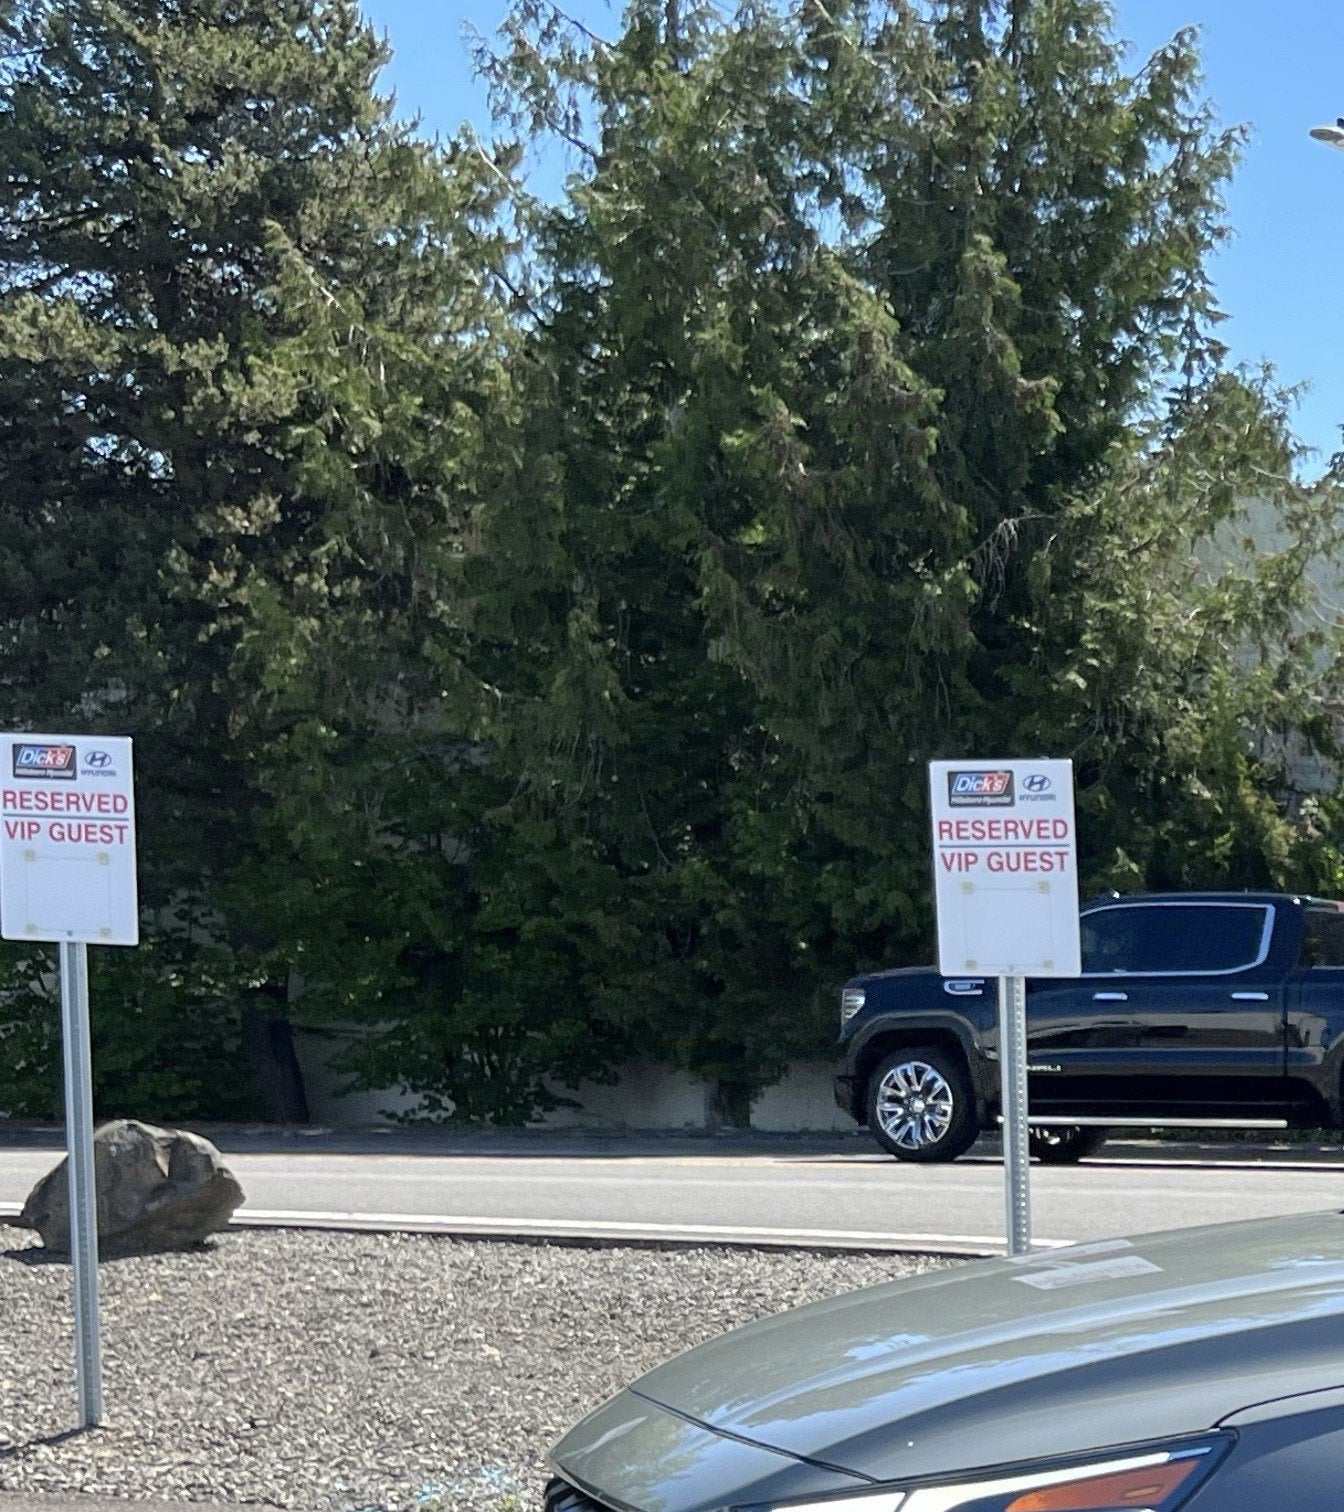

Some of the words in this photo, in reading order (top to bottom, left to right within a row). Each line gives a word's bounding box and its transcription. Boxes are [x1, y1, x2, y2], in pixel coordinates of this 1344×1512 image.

[3, 790, 129, 814] RESERVED
[4, 820, 41, 840] VIP
[49, 822, 129, 845] GUEST
[938, 819, 1068, 841] RESERVED
[941, 852, 979, 872] VIP
[987, 851, 1070, 872] GUEST
